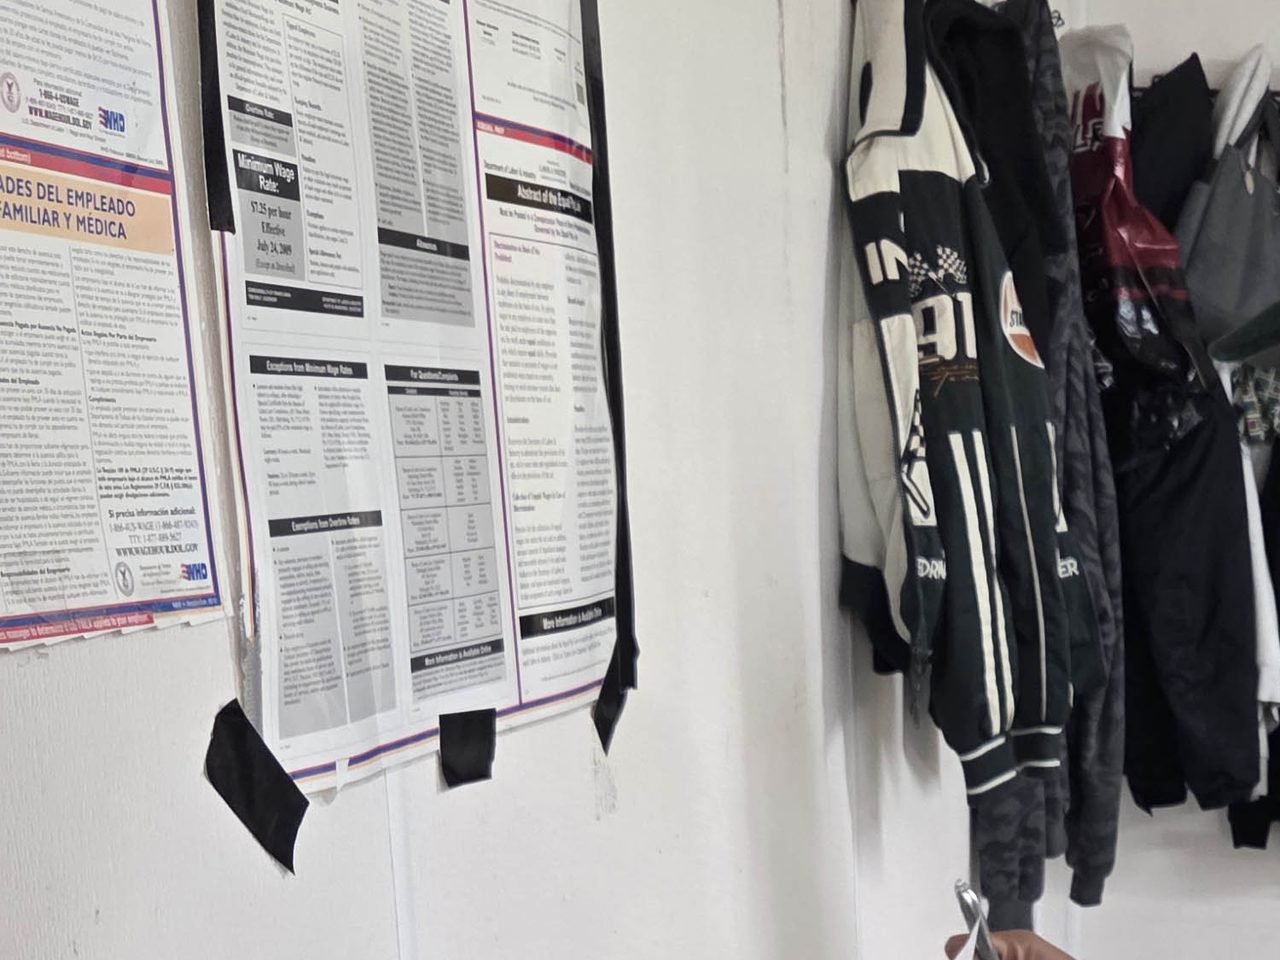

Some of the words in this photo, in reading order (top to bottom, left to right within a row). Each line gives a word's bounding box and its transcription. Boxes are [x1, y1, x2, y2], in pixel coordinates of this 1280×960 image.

[104, 109, 126, 132] WHD
[238, 152, 274, 175] Minimum
[273, 161, 295, 183] Wage
[259, 174, 279, 194] Rate:
[37, 182, 63, 204] DEL
[67, 189, 135, 217] EMPLEADO
[0, 200, 60, 229] AMILIAR
[63, 212, 72, 230] Y
[76, 212, 127, 240] MÉDICA
[257, 239, 269, 255] July
[266, 360, 293, 373] Exceptions
[116, 509, 135, 519] precisa
[136, 508, 169, 517] información
[291, 520, 318, 531] Exceptions
[187, 563, 208, 580] WHD
[436, 652, 458, 665] Information
